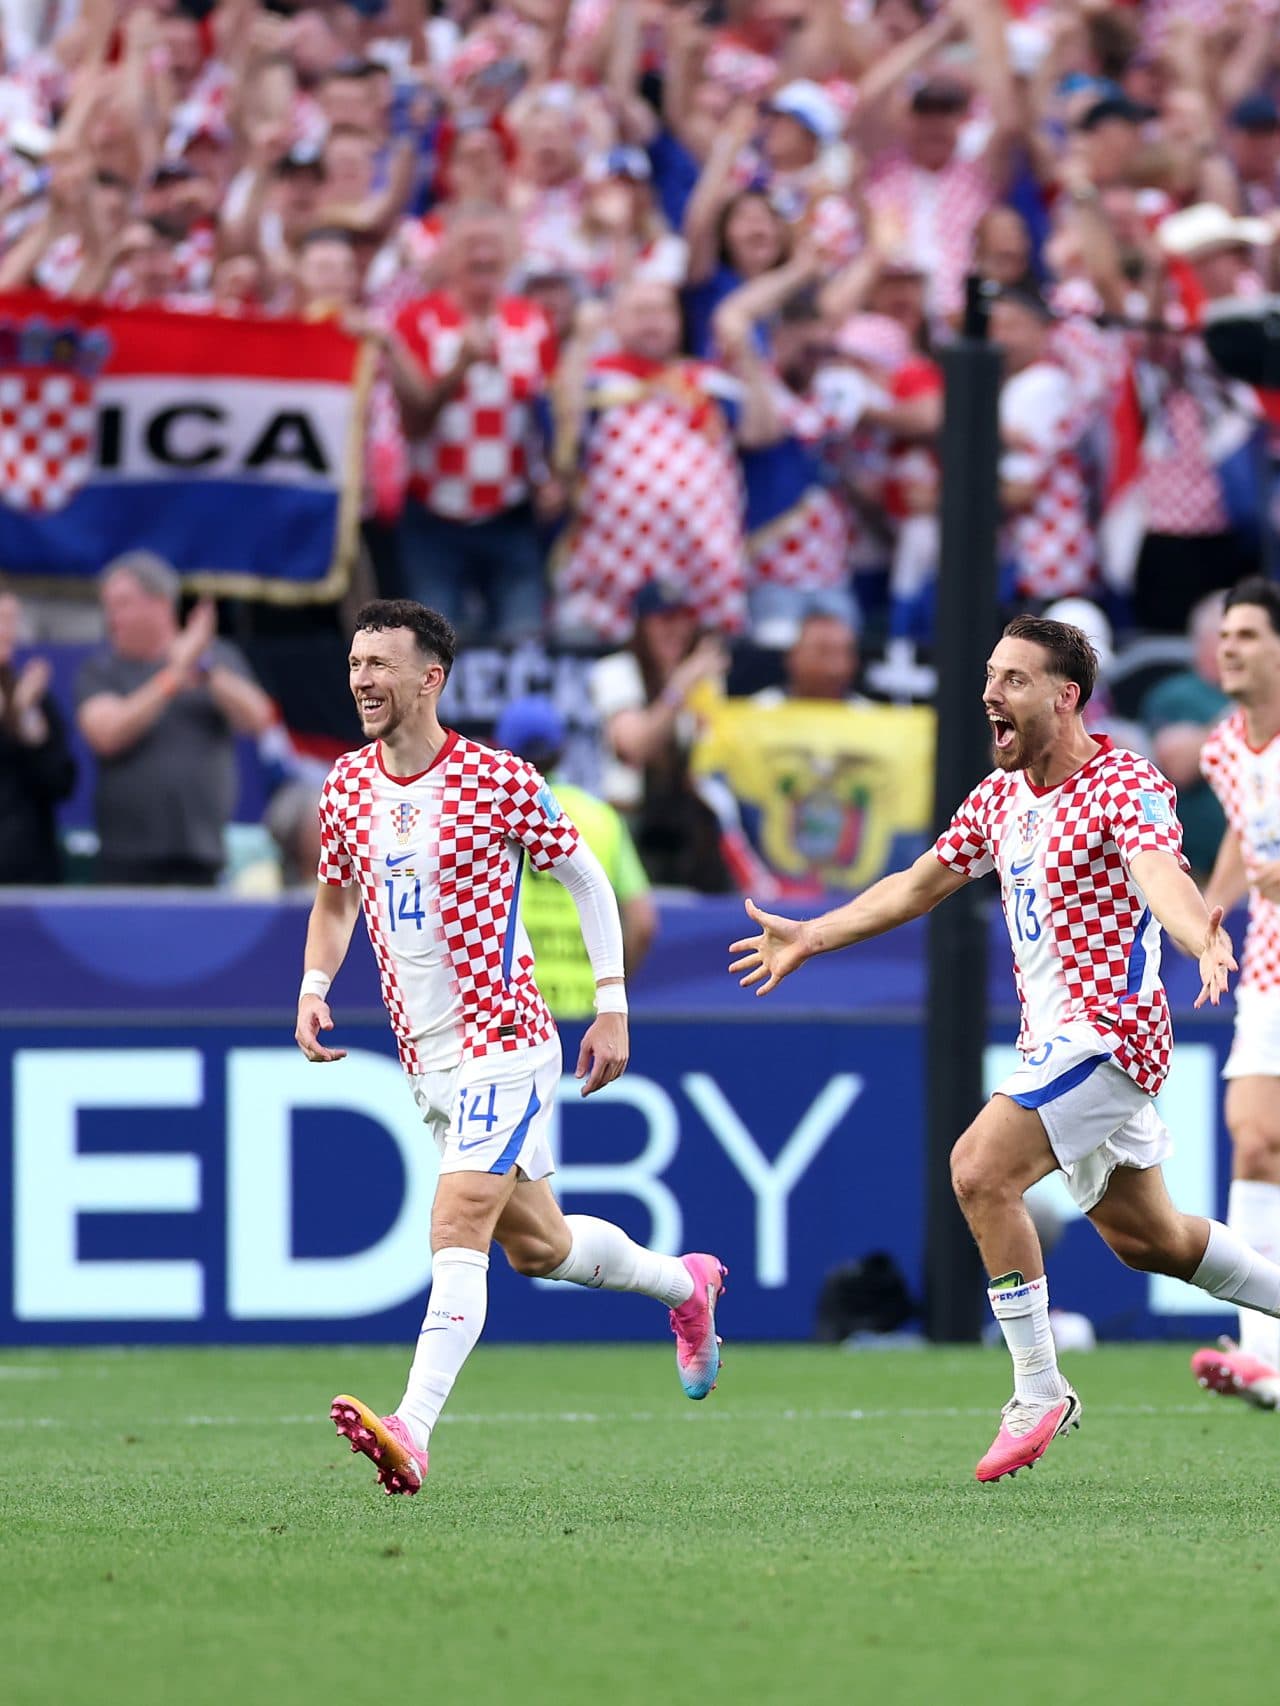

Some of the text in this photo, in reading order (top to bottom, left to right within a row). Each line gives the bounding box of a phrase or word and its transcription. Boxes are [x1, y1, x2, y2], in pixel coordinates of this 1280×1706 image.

[385, 878, 425, 932] 14
[1014, 888, 1042, 942] 13
[458, 1084, 499, 1134] 14
[13, 1048, 442, 1320] ED
[535, 1072, 866, 1291] BY
